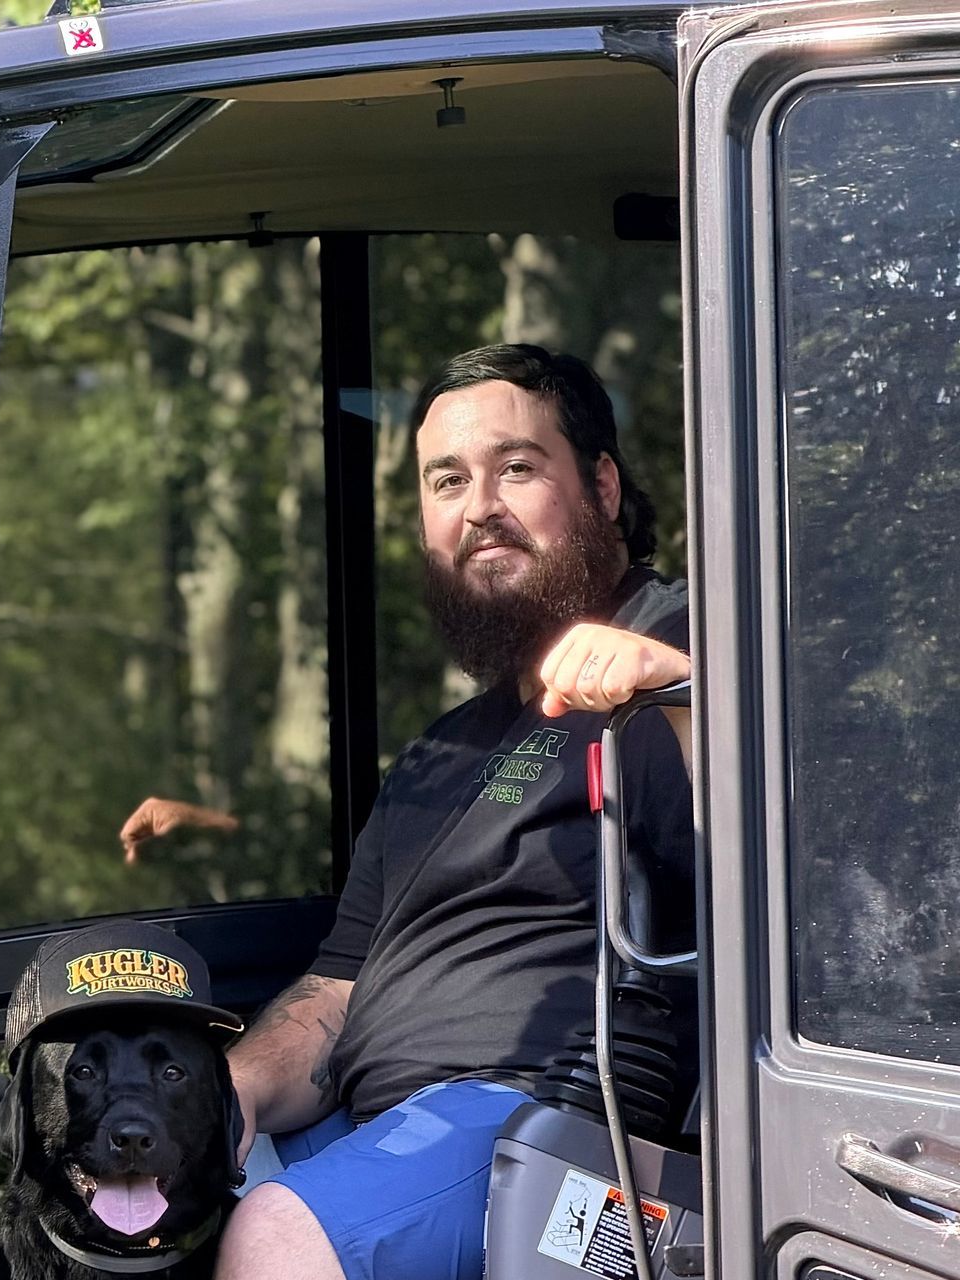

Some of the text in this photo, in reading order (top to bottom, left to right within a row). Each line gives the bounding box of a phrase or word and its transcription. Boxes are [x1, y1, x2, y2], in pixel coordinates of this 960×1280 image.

[513, 727, 570, 758] ER
[67, 950, 192, 994] KUGLER
[90, 975, 171, 994] DIRTWORKS
[641, 1201, 662, 1217] NING
